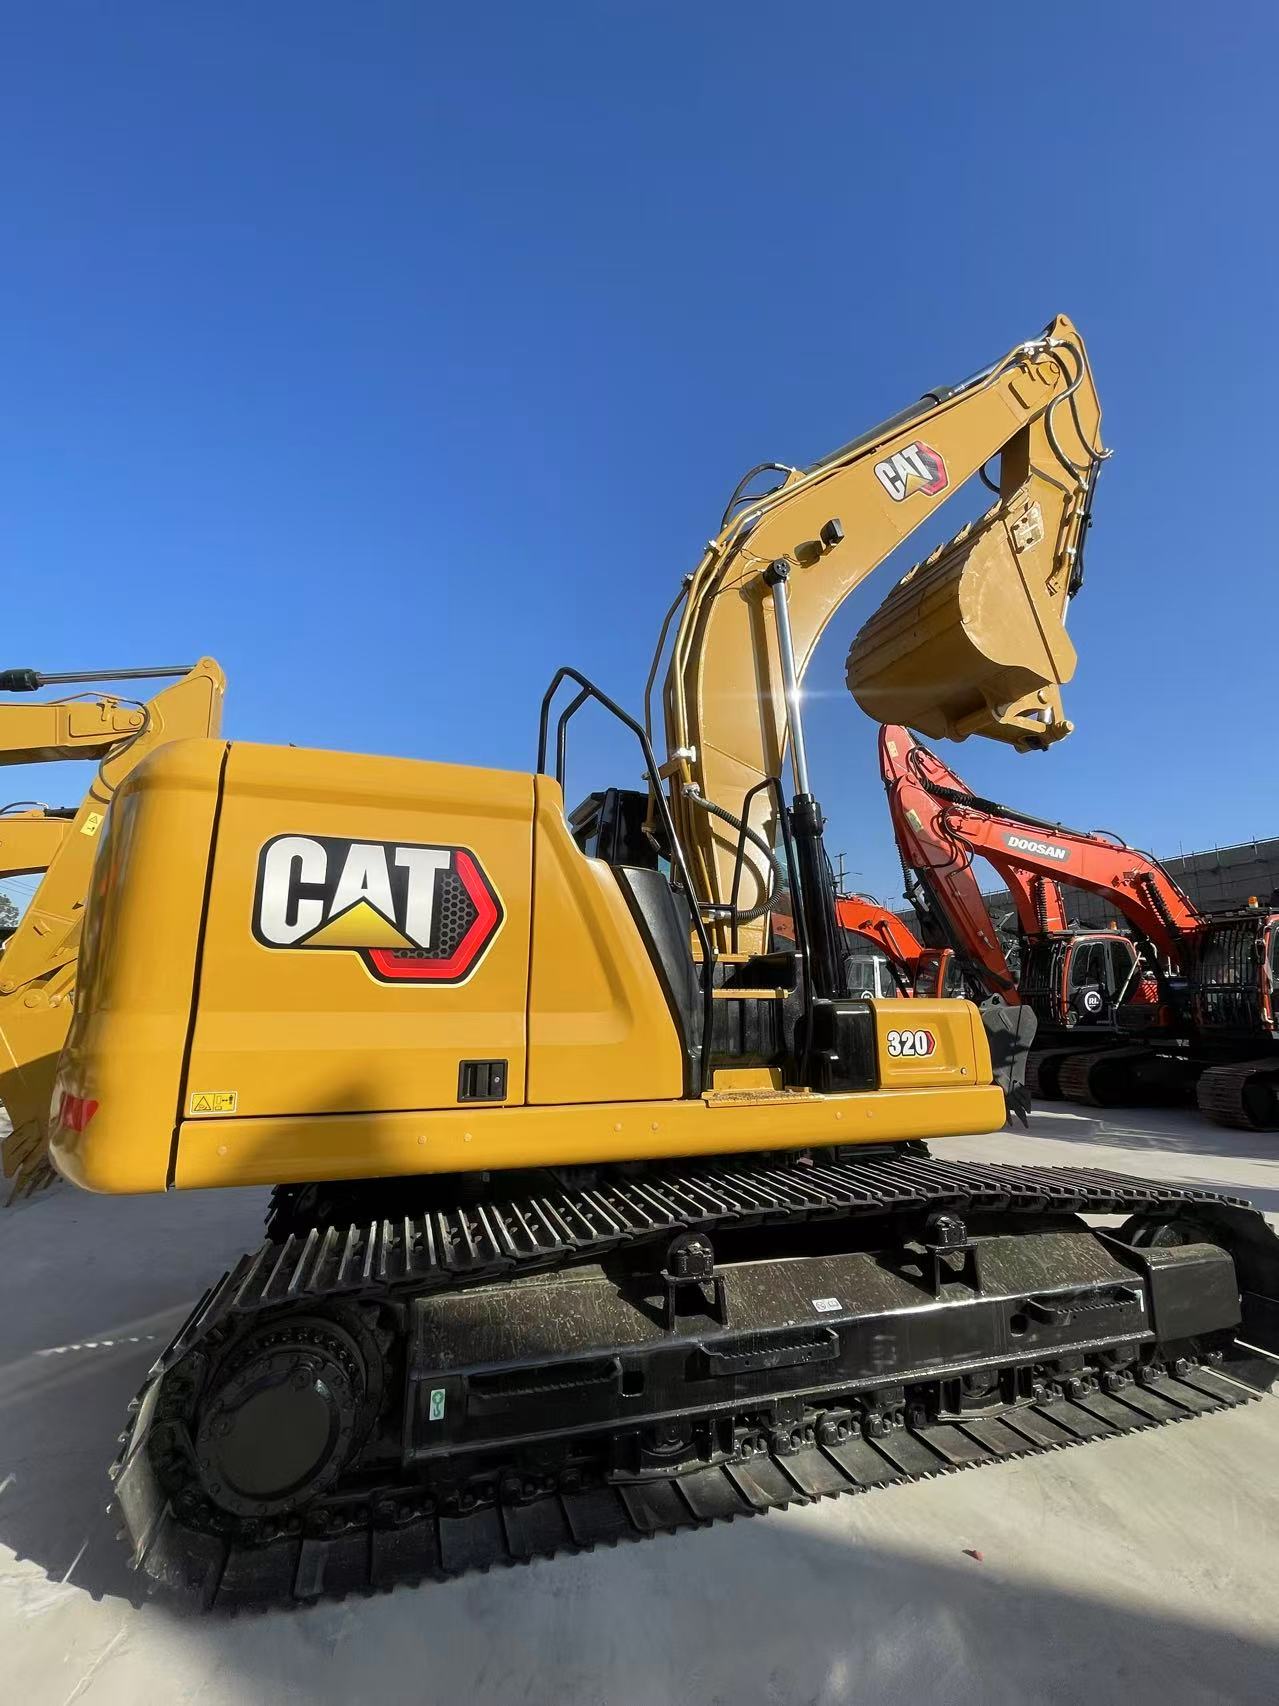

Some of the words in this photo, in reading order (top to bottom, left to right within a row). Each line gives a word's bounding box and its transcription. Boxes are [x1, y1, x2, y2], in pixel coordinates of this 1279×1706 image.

[875, 444, 934, 500] CAT
[1007, 836, 1066, 860] DOOSAN
[260, 836, 451, 949] CAT
[887, 1031, 928, 1056] 320
